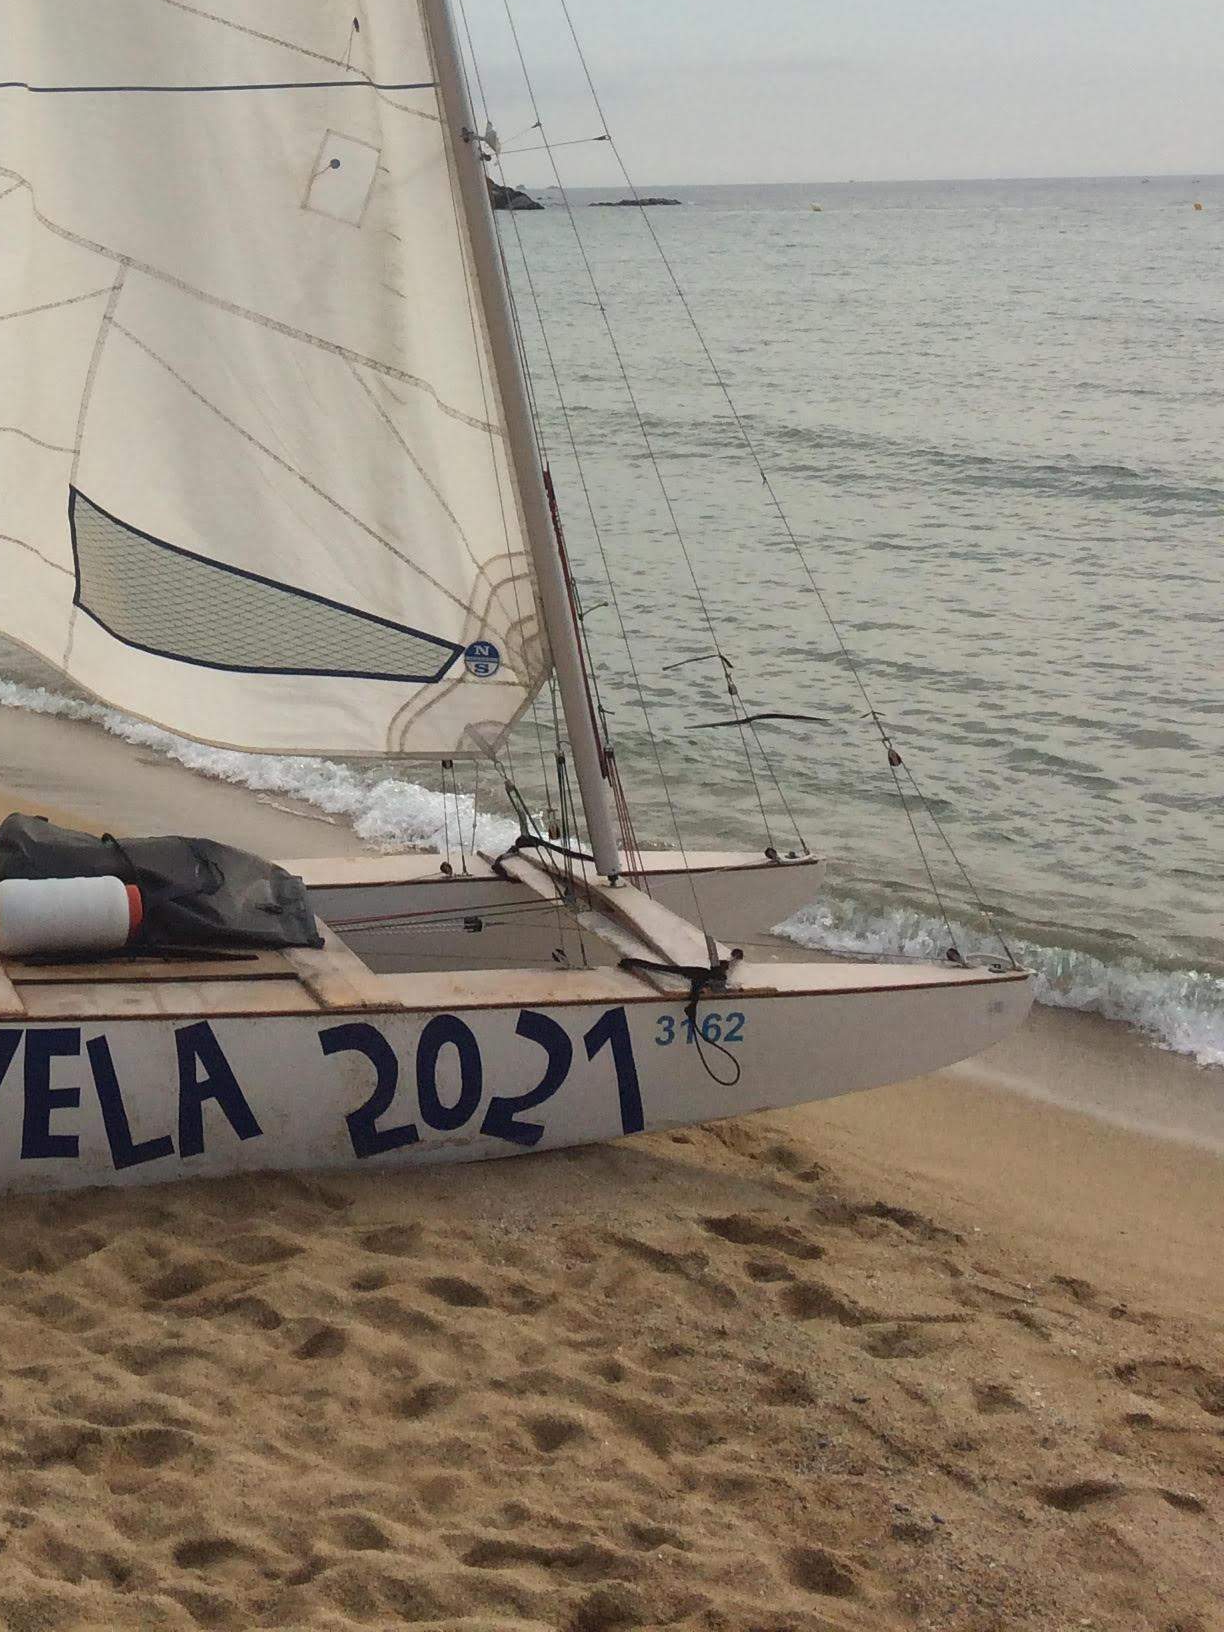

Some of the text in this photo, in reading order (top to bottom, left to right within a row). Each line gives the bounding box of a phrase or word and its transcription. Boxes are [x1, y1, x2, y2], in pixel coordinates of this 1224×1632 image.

[473, 644, 489, 656] N
[474, 663, 489, 673] S
[654, 1012, 746, 1046] 3162
[318, 1006, 645, 1159] 2021
